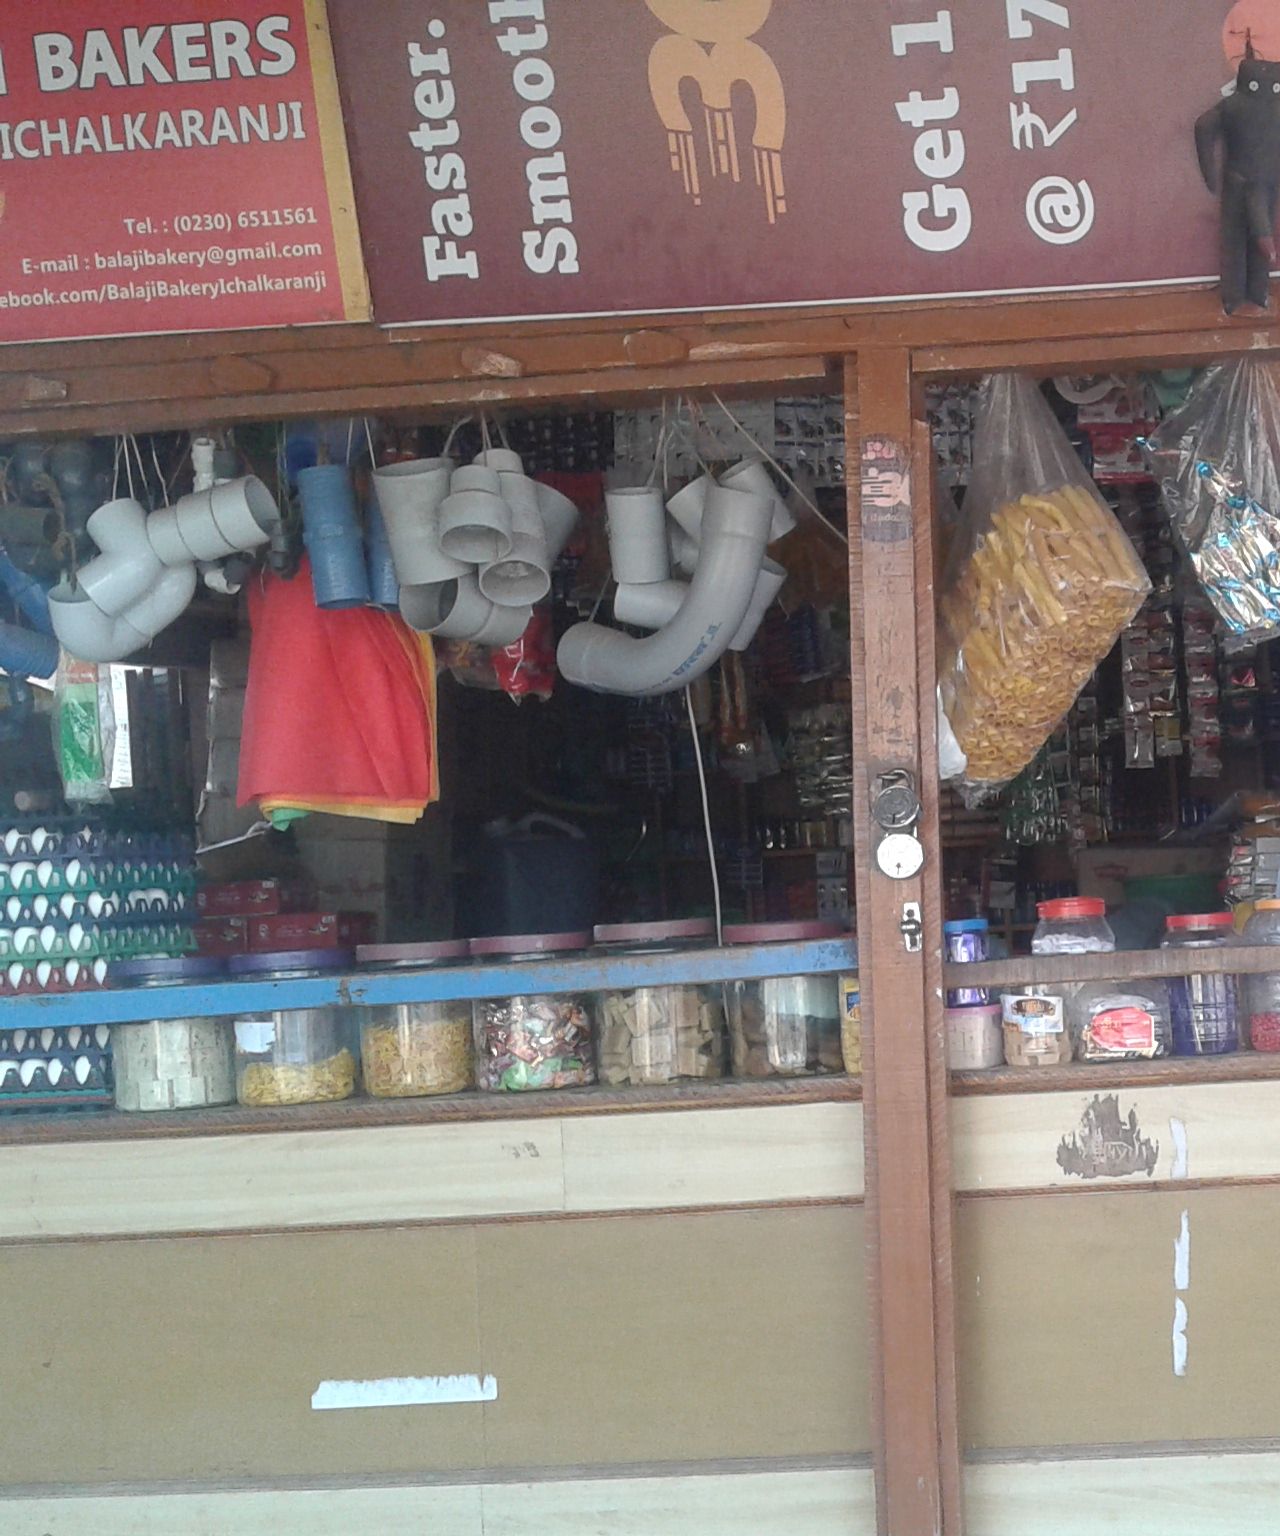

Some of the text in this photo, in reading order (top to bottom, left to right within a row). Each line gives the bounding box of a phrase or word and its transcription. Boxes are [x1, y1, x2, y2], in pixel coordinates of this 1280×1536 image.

[33, 16, 297, 92] BAKERS
[0, 101, 306, 160] ICHALKARANJI
[408, 18, 480, 281] Faster.
[894, 87, 972, 252] Get
[123, 217, 158, 235] Tel.
[173, 213, 232, 236] (0230)
[237, 207, 318, 229] 6511561
[1025, 175, 1095, 245] @
[21, 253, 79, 275] E-mail
[95, 242, 322, 271] balajibakery@gmail.com
